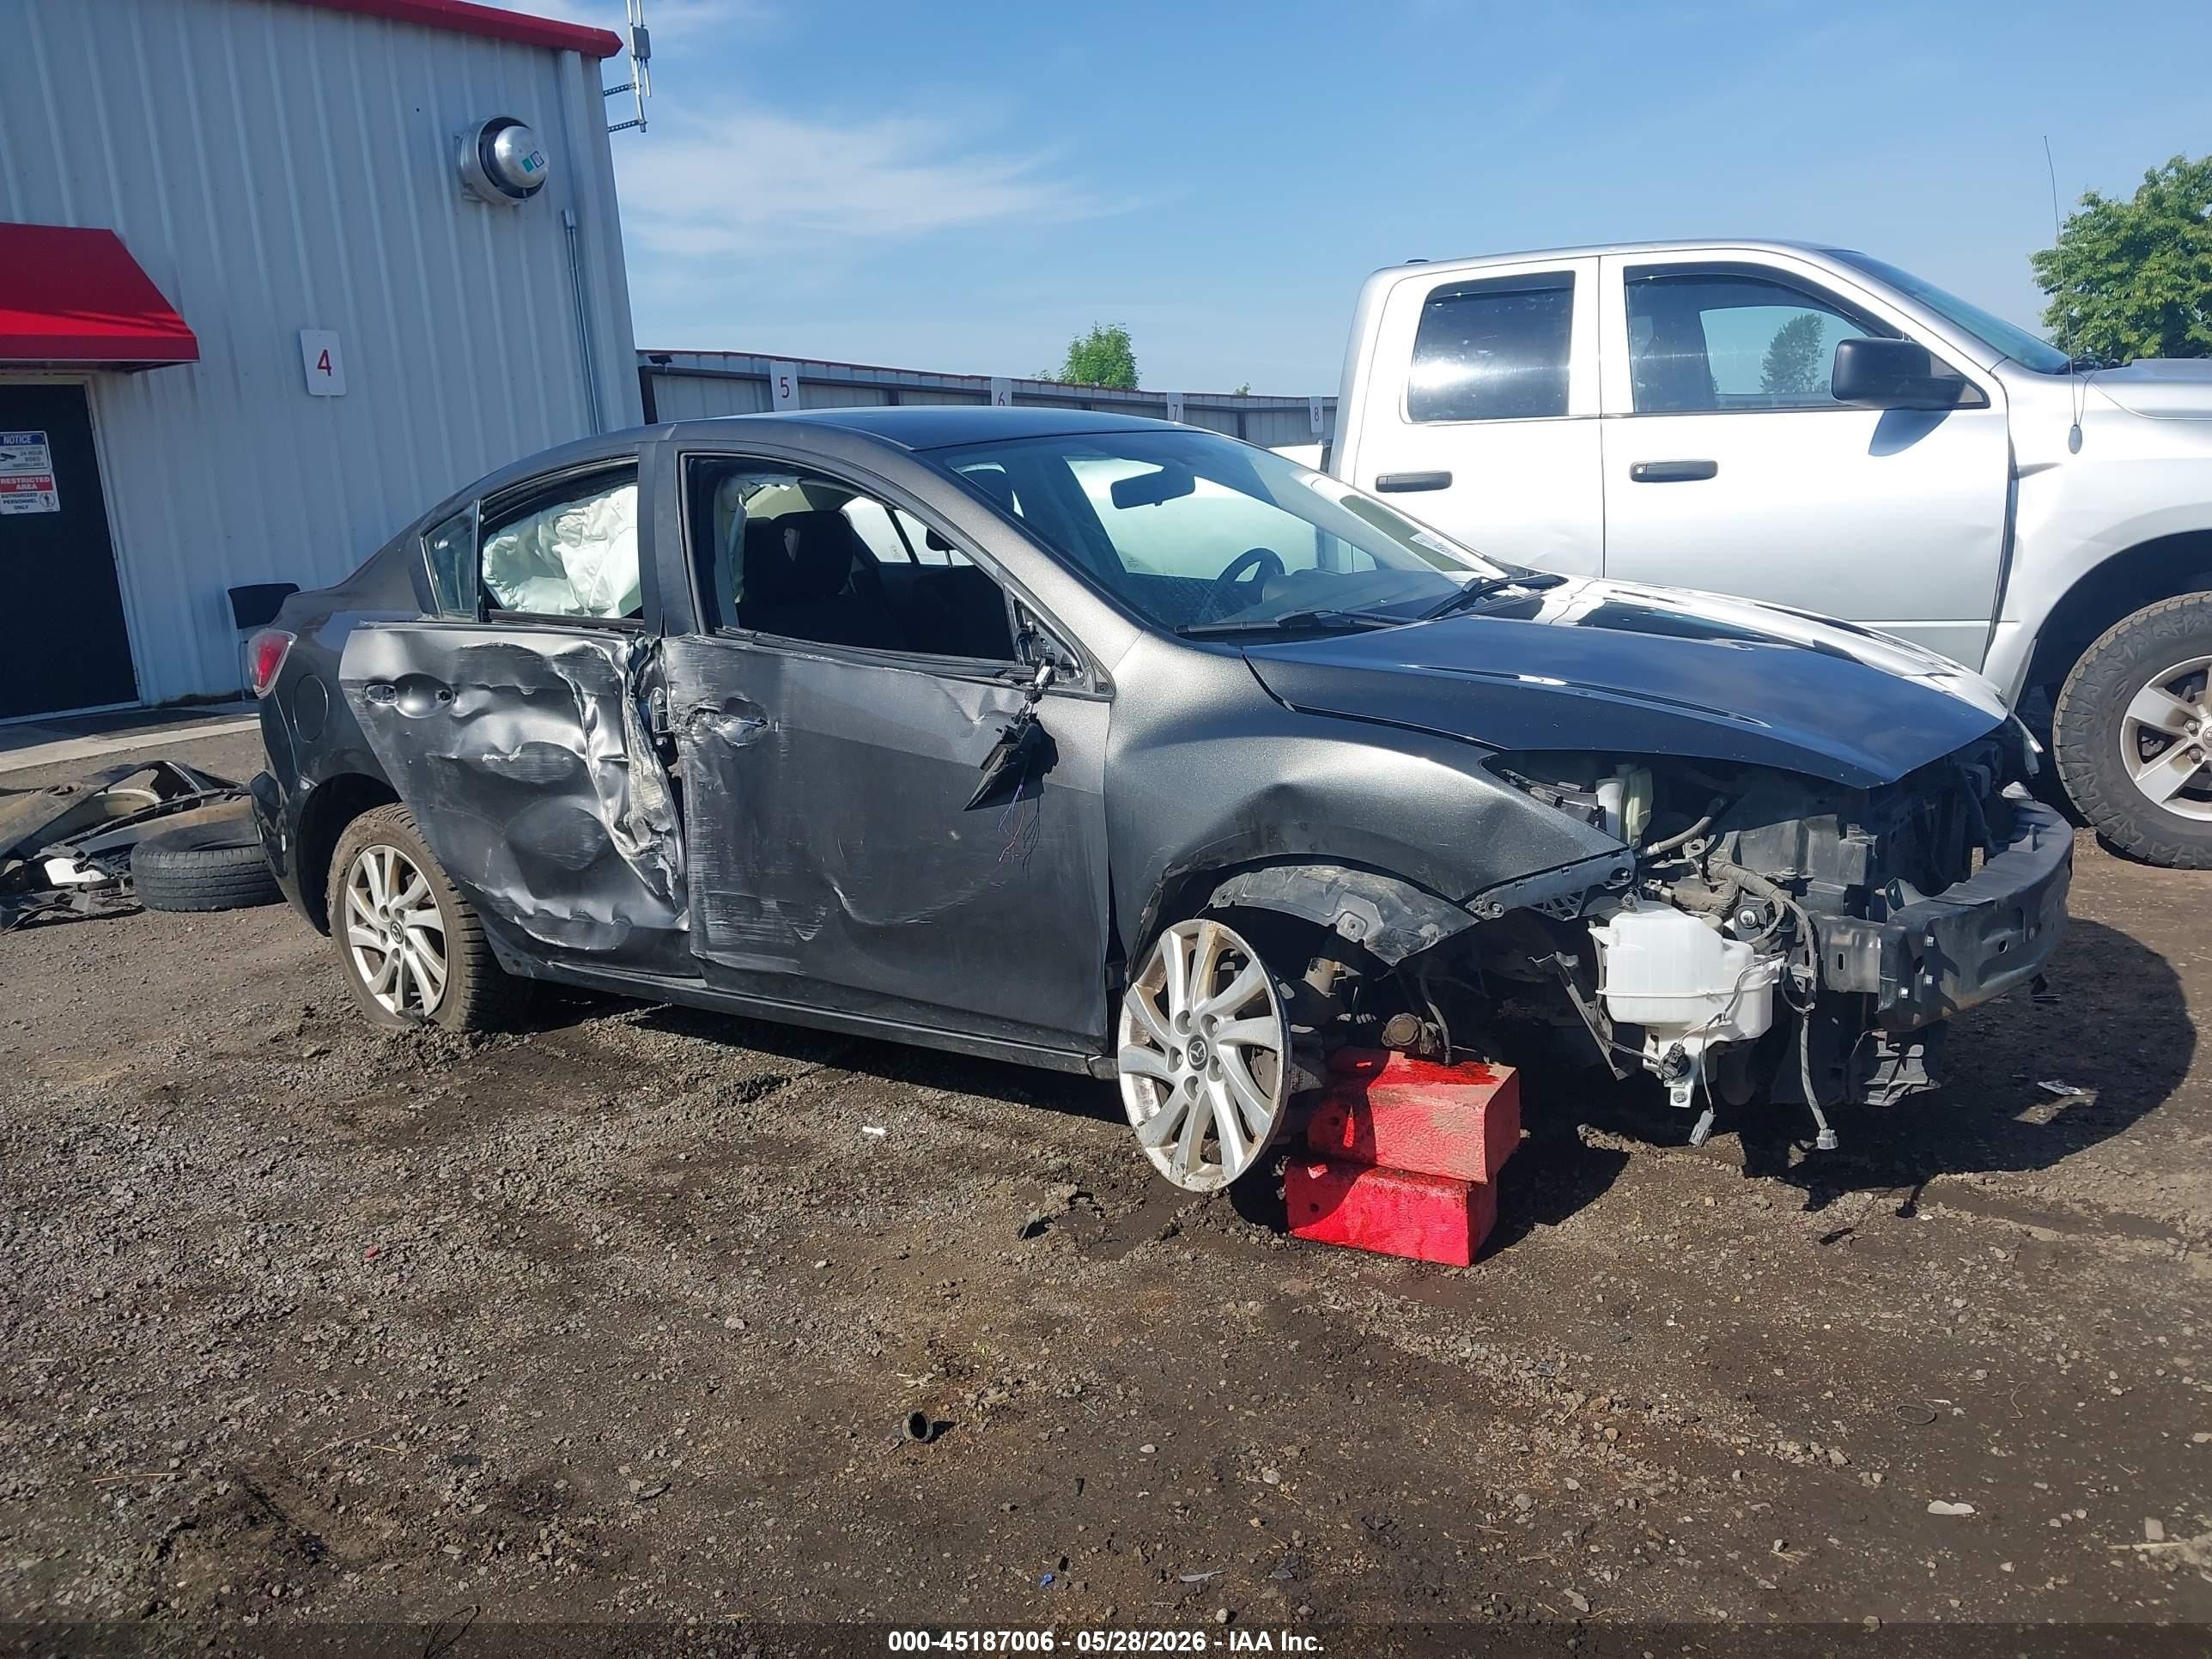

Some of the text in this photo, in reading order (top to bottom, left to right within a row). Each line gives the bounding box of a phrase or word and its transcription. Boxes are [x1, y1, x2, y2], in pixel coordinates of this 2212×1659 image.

[316, 349, 332, 377] 4
[780, 376, 790, 399] 5
[1172, 404, 1178, 422] 7
[1314, 405, 1320, 422] 8
[3, 435, 32, 445] NOTICE
